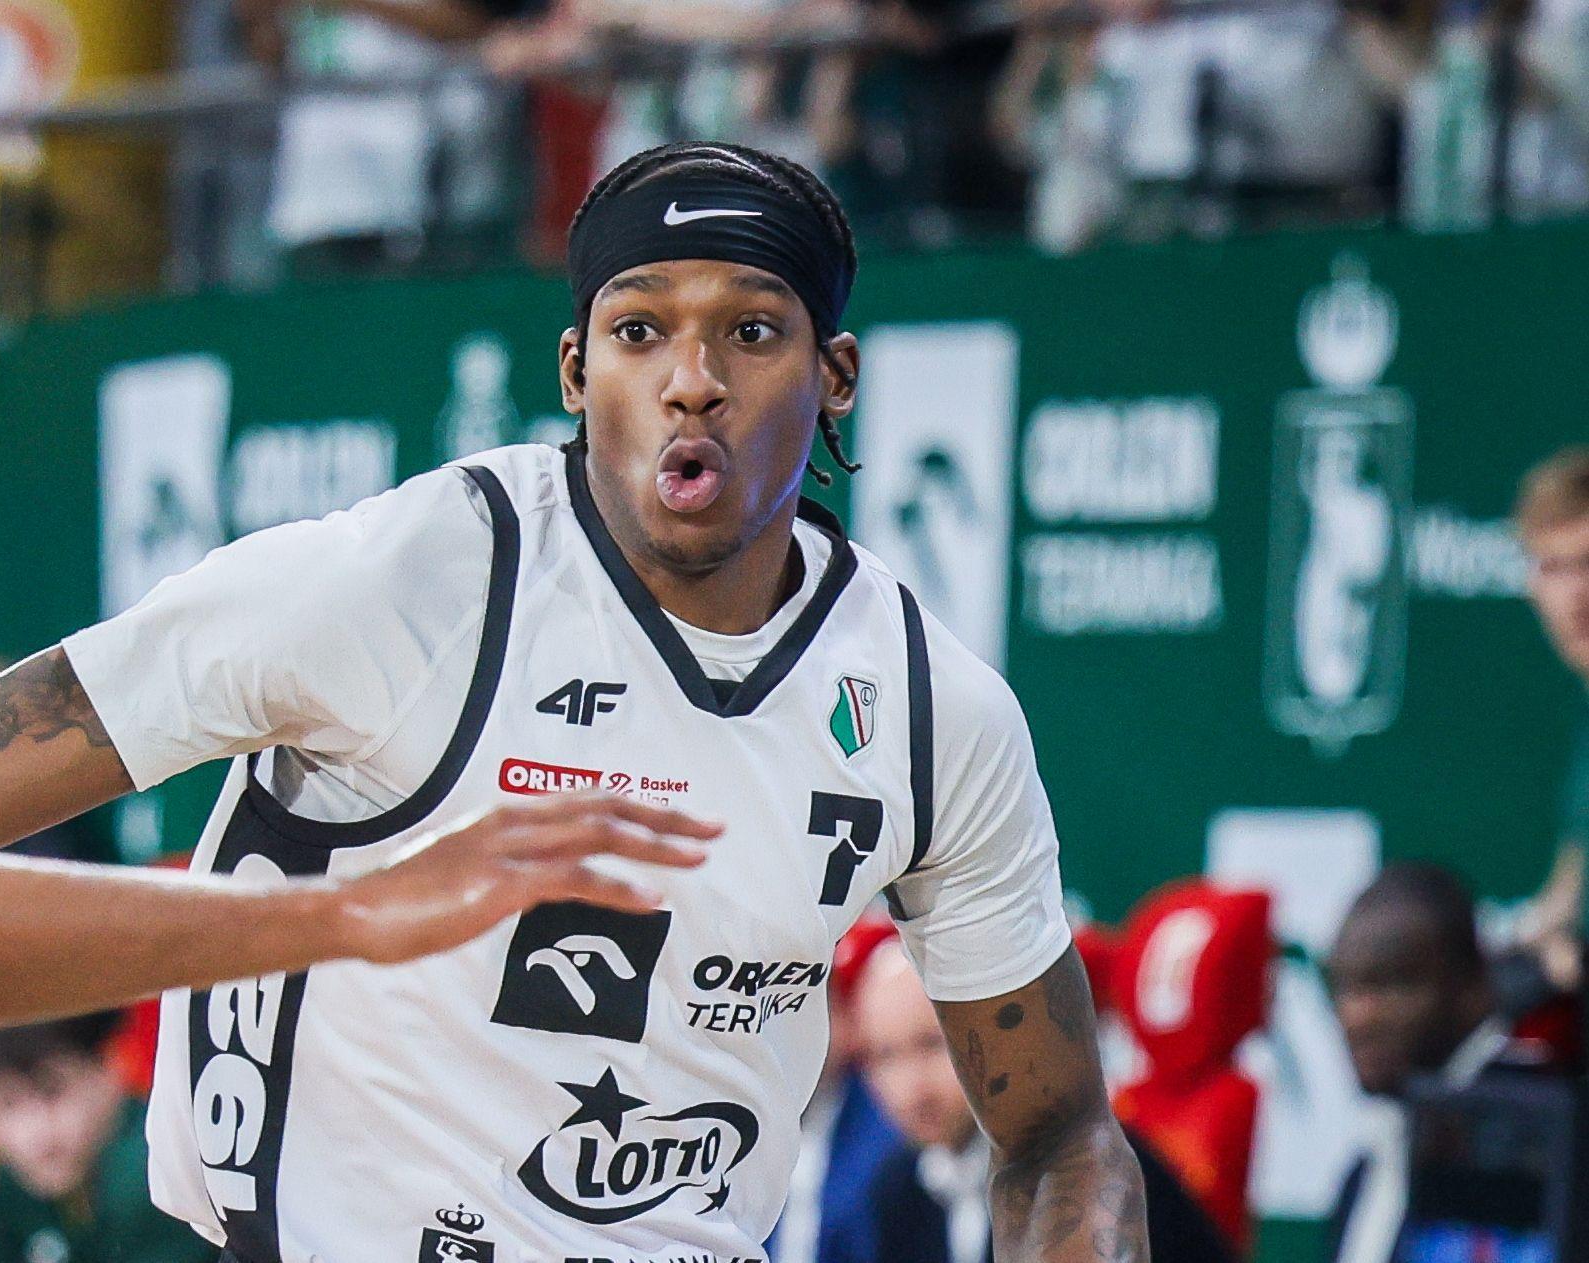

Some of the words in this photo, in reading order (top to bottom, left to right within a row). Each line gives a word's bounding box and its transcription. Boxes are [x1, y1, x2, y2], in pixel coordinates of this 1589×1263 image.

[536, 679, 627, 726] 4F
[507, 765, 593, 792] ORLEN
[641, 776, 688, 793] Basket
[808, 790, 883, 906] 7
[693, 954, 828, 996] ORLEN
[193, 853, 288, 1221] 192
[576, 1126, 722, 1198] LOTTO
